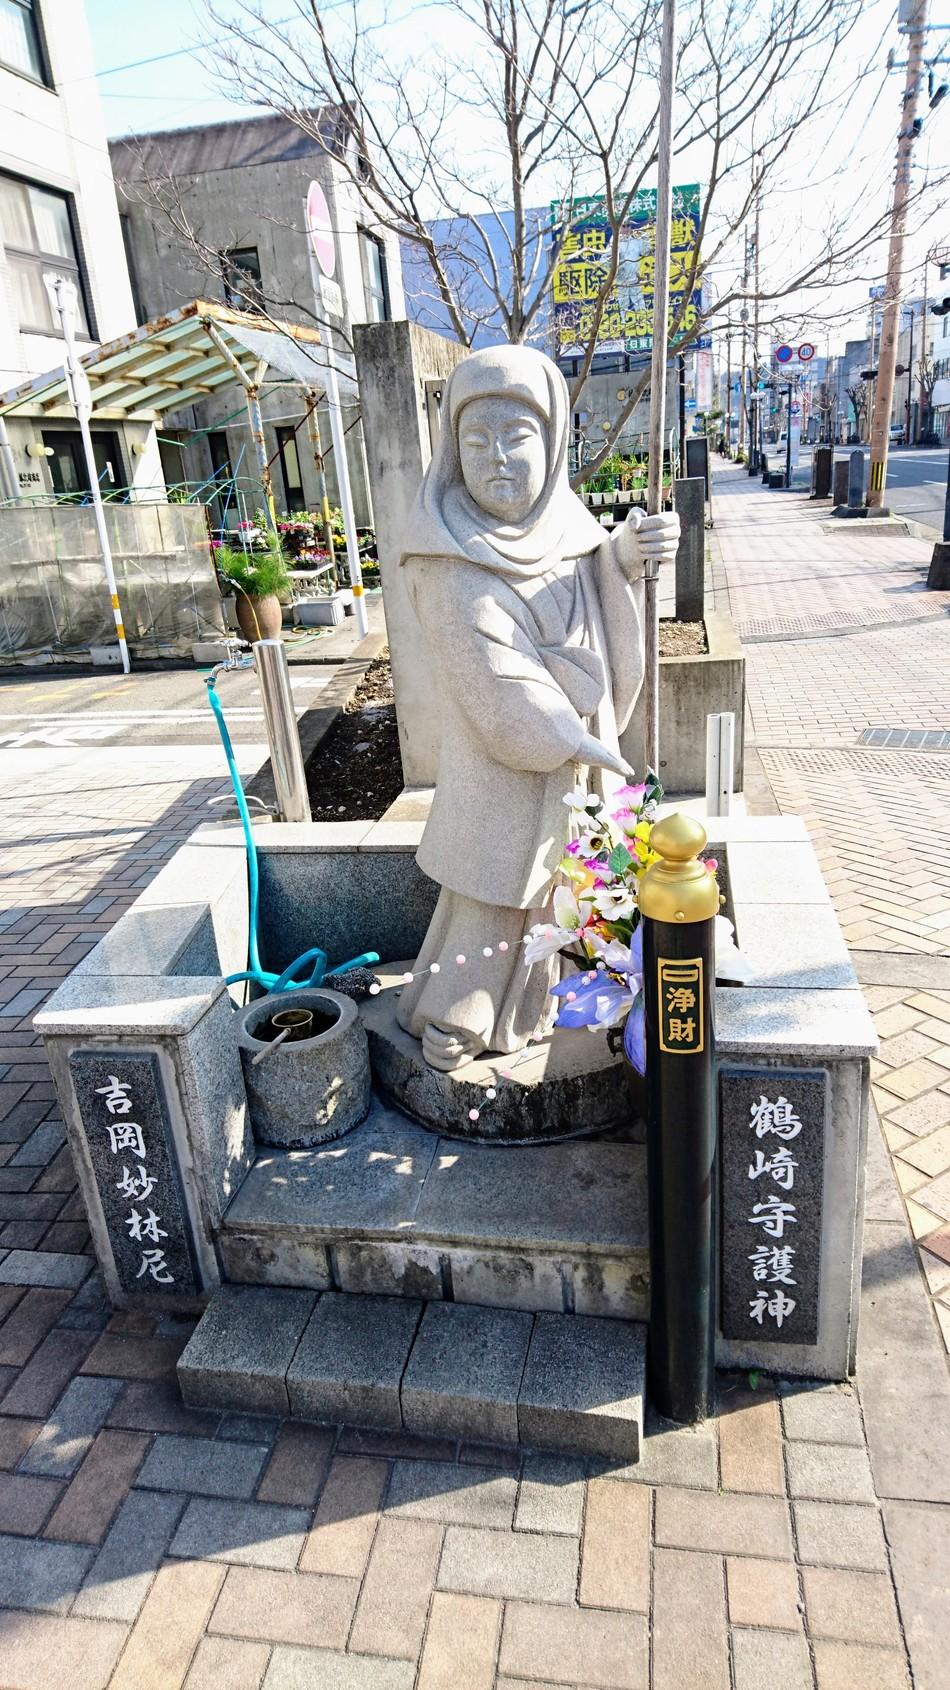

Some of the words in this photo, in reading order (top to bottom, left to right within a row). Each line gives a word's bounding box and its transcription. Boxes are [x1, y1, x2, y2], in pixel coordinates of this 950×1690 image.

[559, 266, 608, 297] 駆除
[801, 347, 811, 356] 40
[666, 987, 696, 1042] 浄財
[95, 1075, 175, 1283] 吉岡妙林尼
[748, 1095, 803, 1328] 鶴崎守護神
